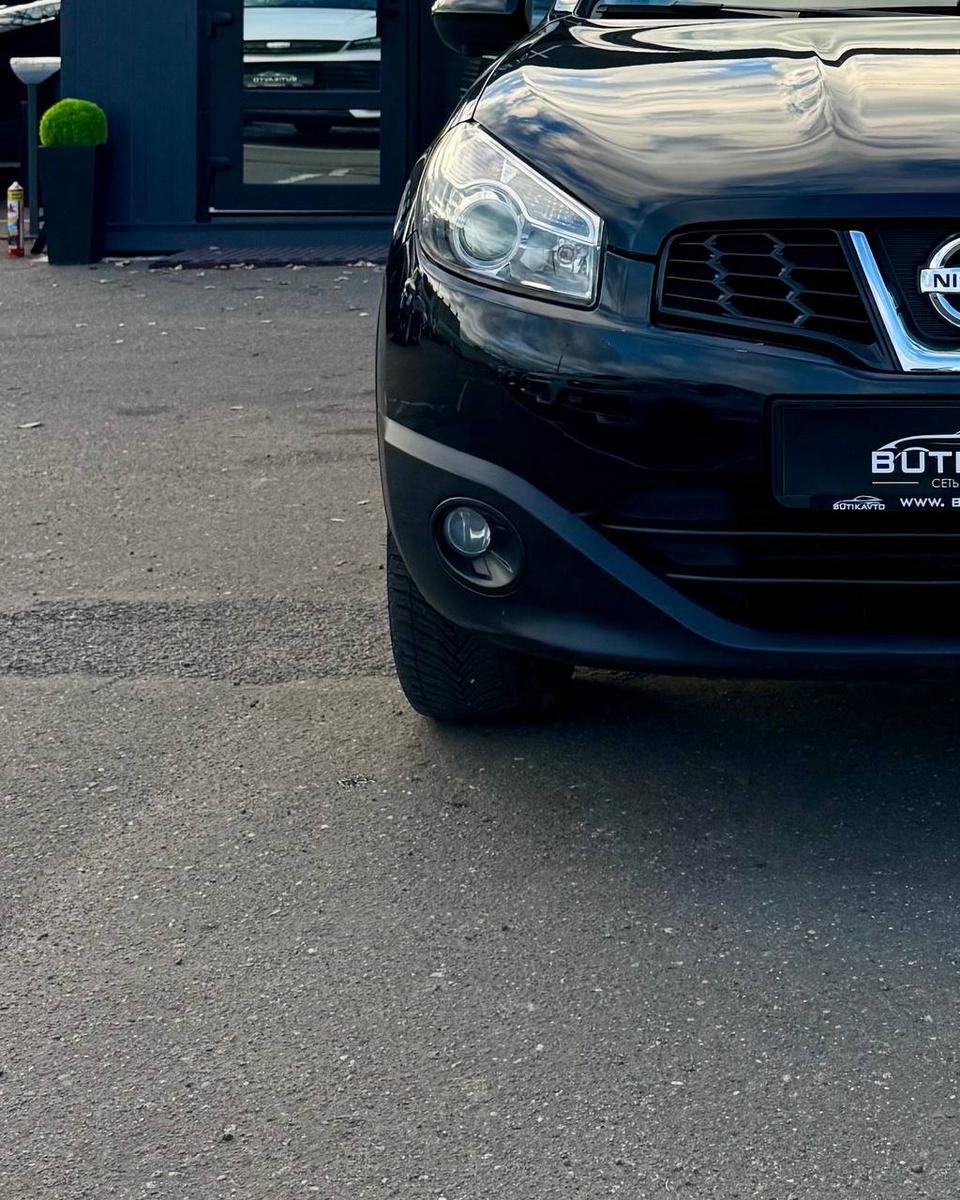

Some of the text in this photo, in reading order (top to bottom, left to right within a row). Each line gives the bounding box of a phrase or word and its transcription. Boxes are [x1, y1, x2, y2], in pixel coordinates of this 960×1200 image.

[931, 478, 960, 489] СЕТЬ
[832, 502, 885, 511] BUTIKAVTO
[899, 497, 945, 508] WWW.
